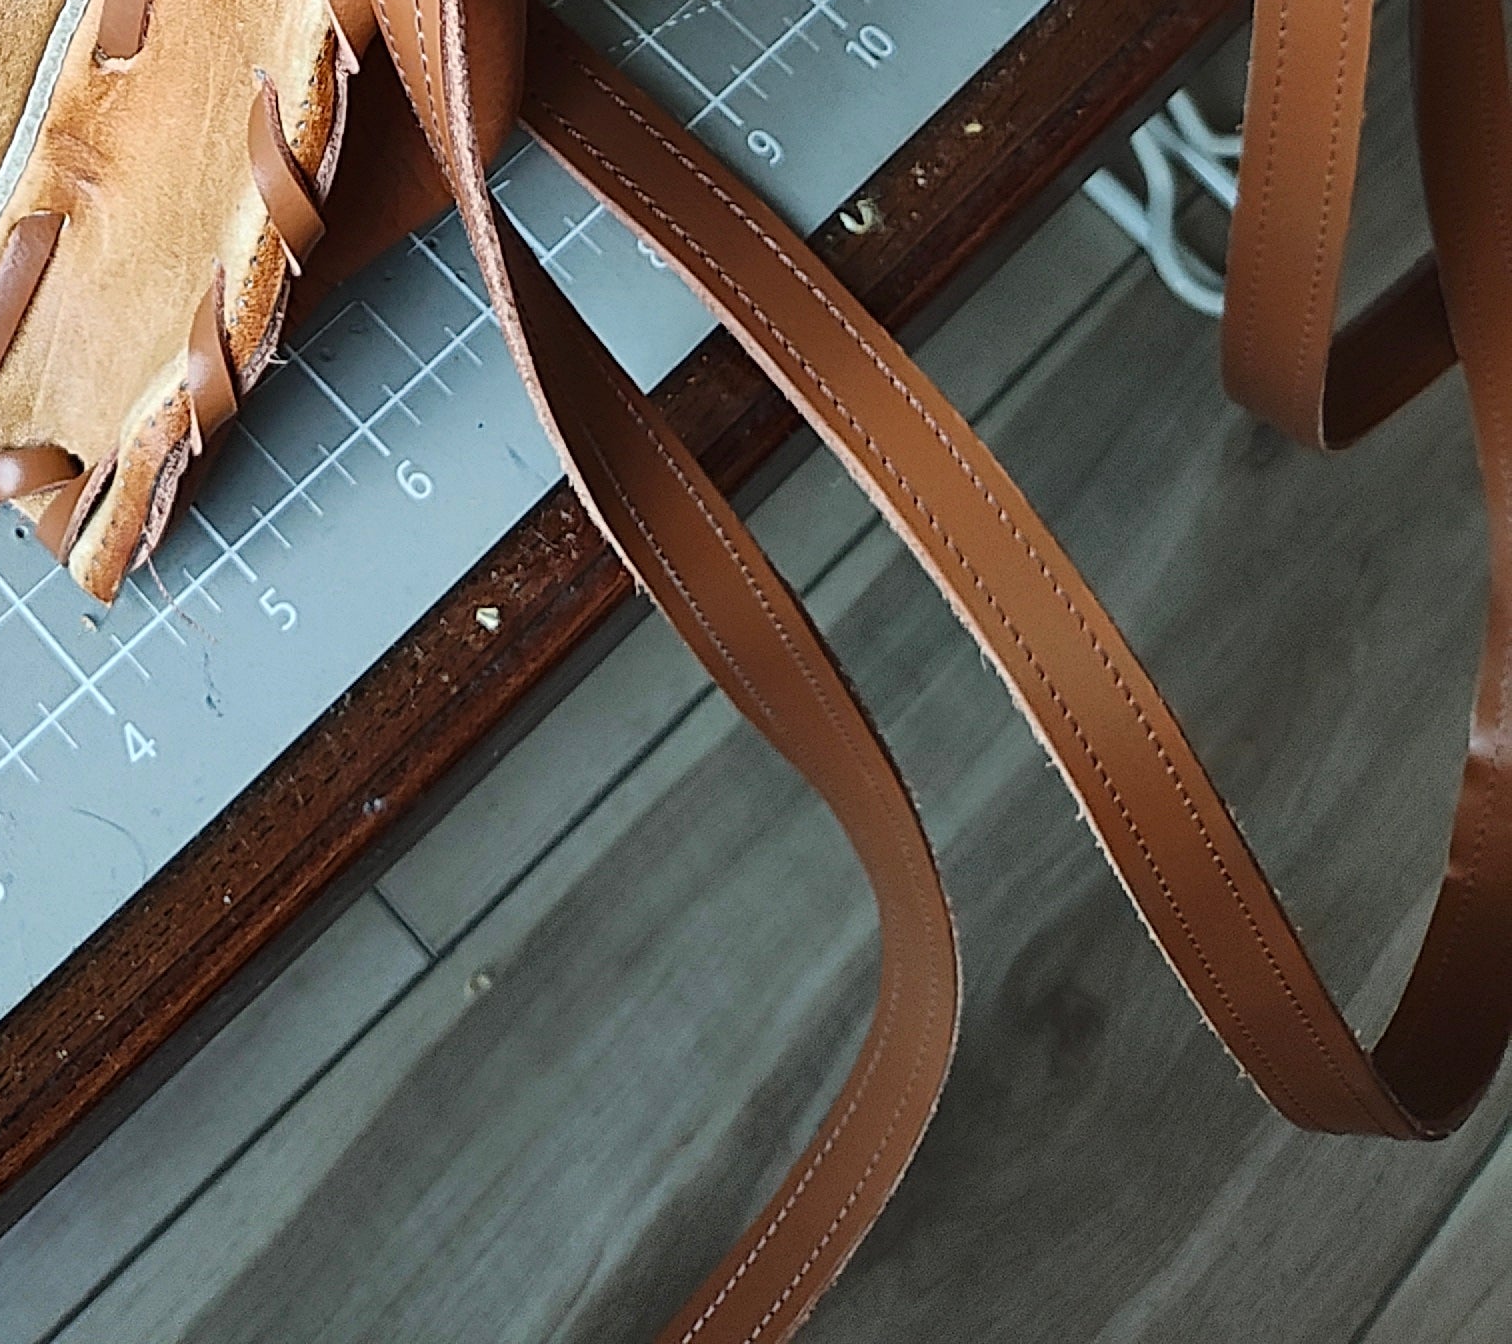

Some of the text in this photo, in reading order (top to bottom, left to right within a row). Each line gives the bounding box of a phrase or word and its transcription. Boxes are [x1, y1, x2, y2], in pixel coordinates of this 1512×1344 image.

[845, 23, 896, 70] 10
[747, 129, 784, 165] 9
[395, 459, 434, 501] 6
[258, 586, 299, 632] 5
[122, 721, 158, 763] 4
